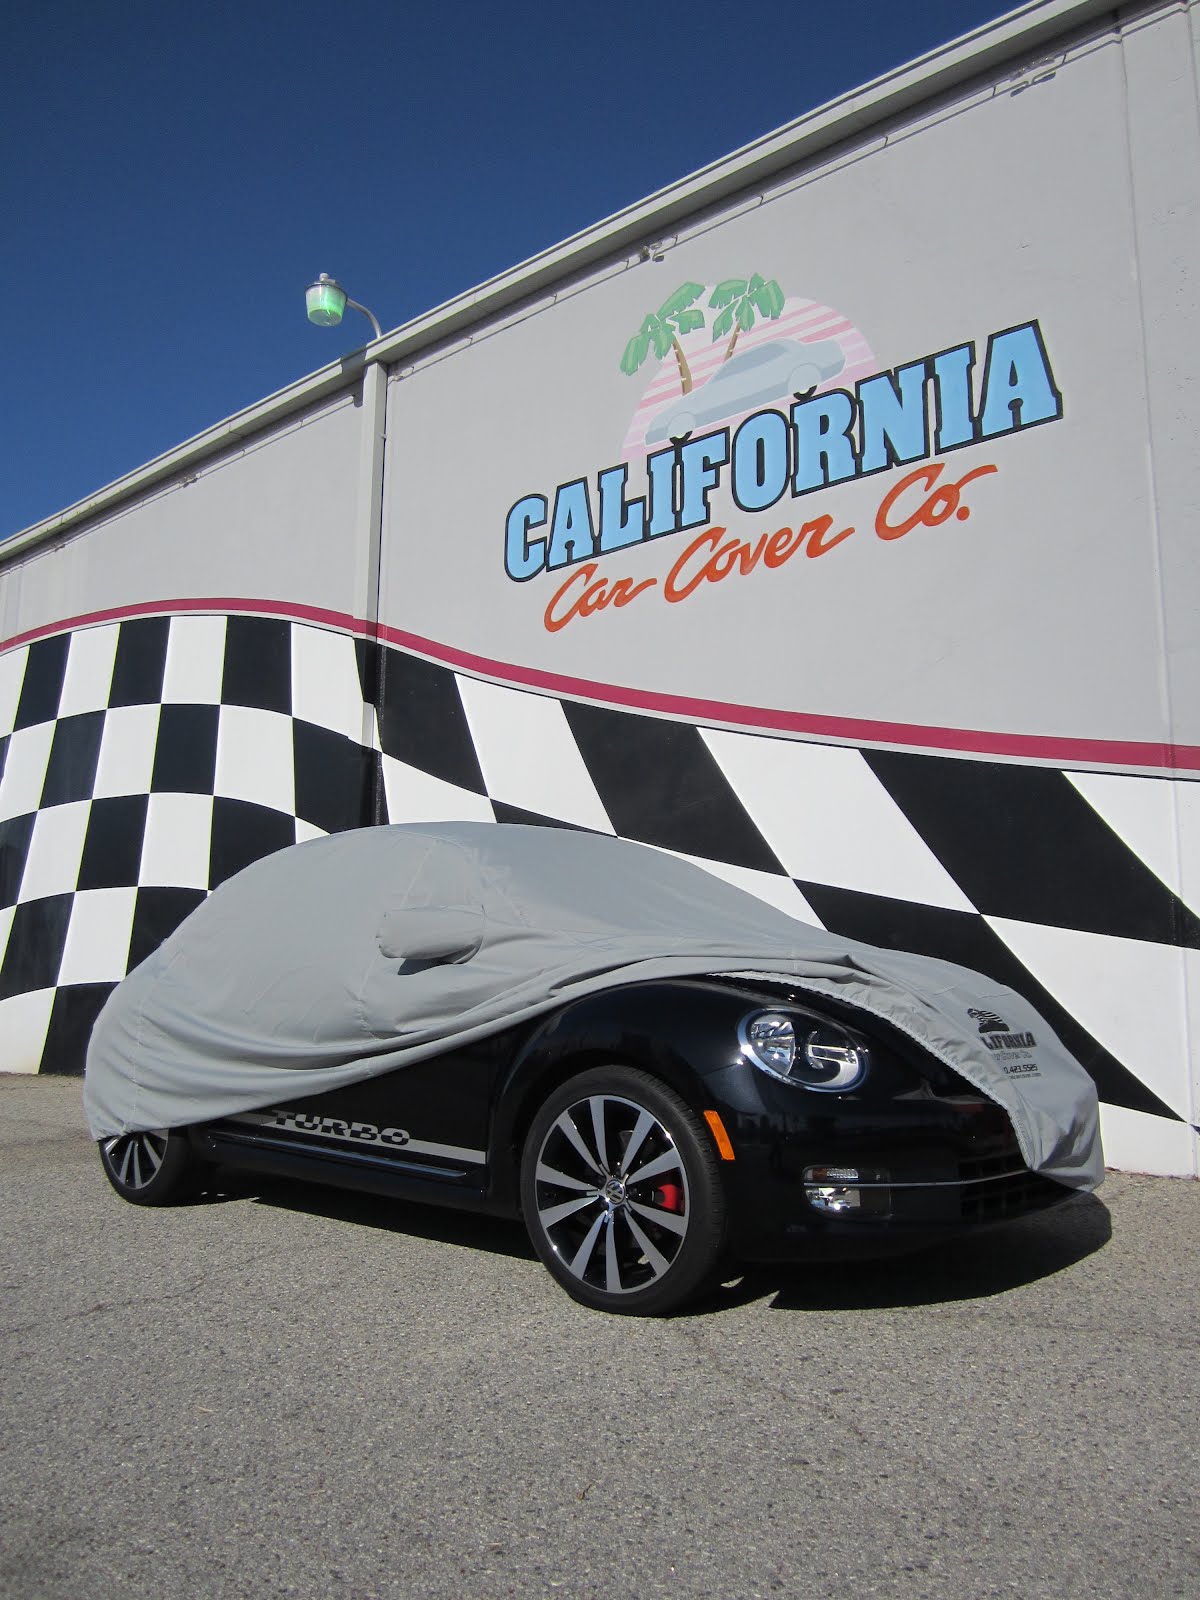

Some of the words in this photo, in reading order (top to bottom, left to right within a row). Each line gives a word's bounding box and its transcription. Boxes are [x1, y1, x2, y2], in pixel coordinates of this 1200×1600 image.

[503, 318, 1063, 583] CALIFORNIA
[544, 563, 657, 633] Car
[663, 514, 855, 603] Cover
[874, 462, 998, 541] Co.
[979, 1032, 1036, 1050] LIFORNIA
[272, 1109, 410, 1146] TURBO
